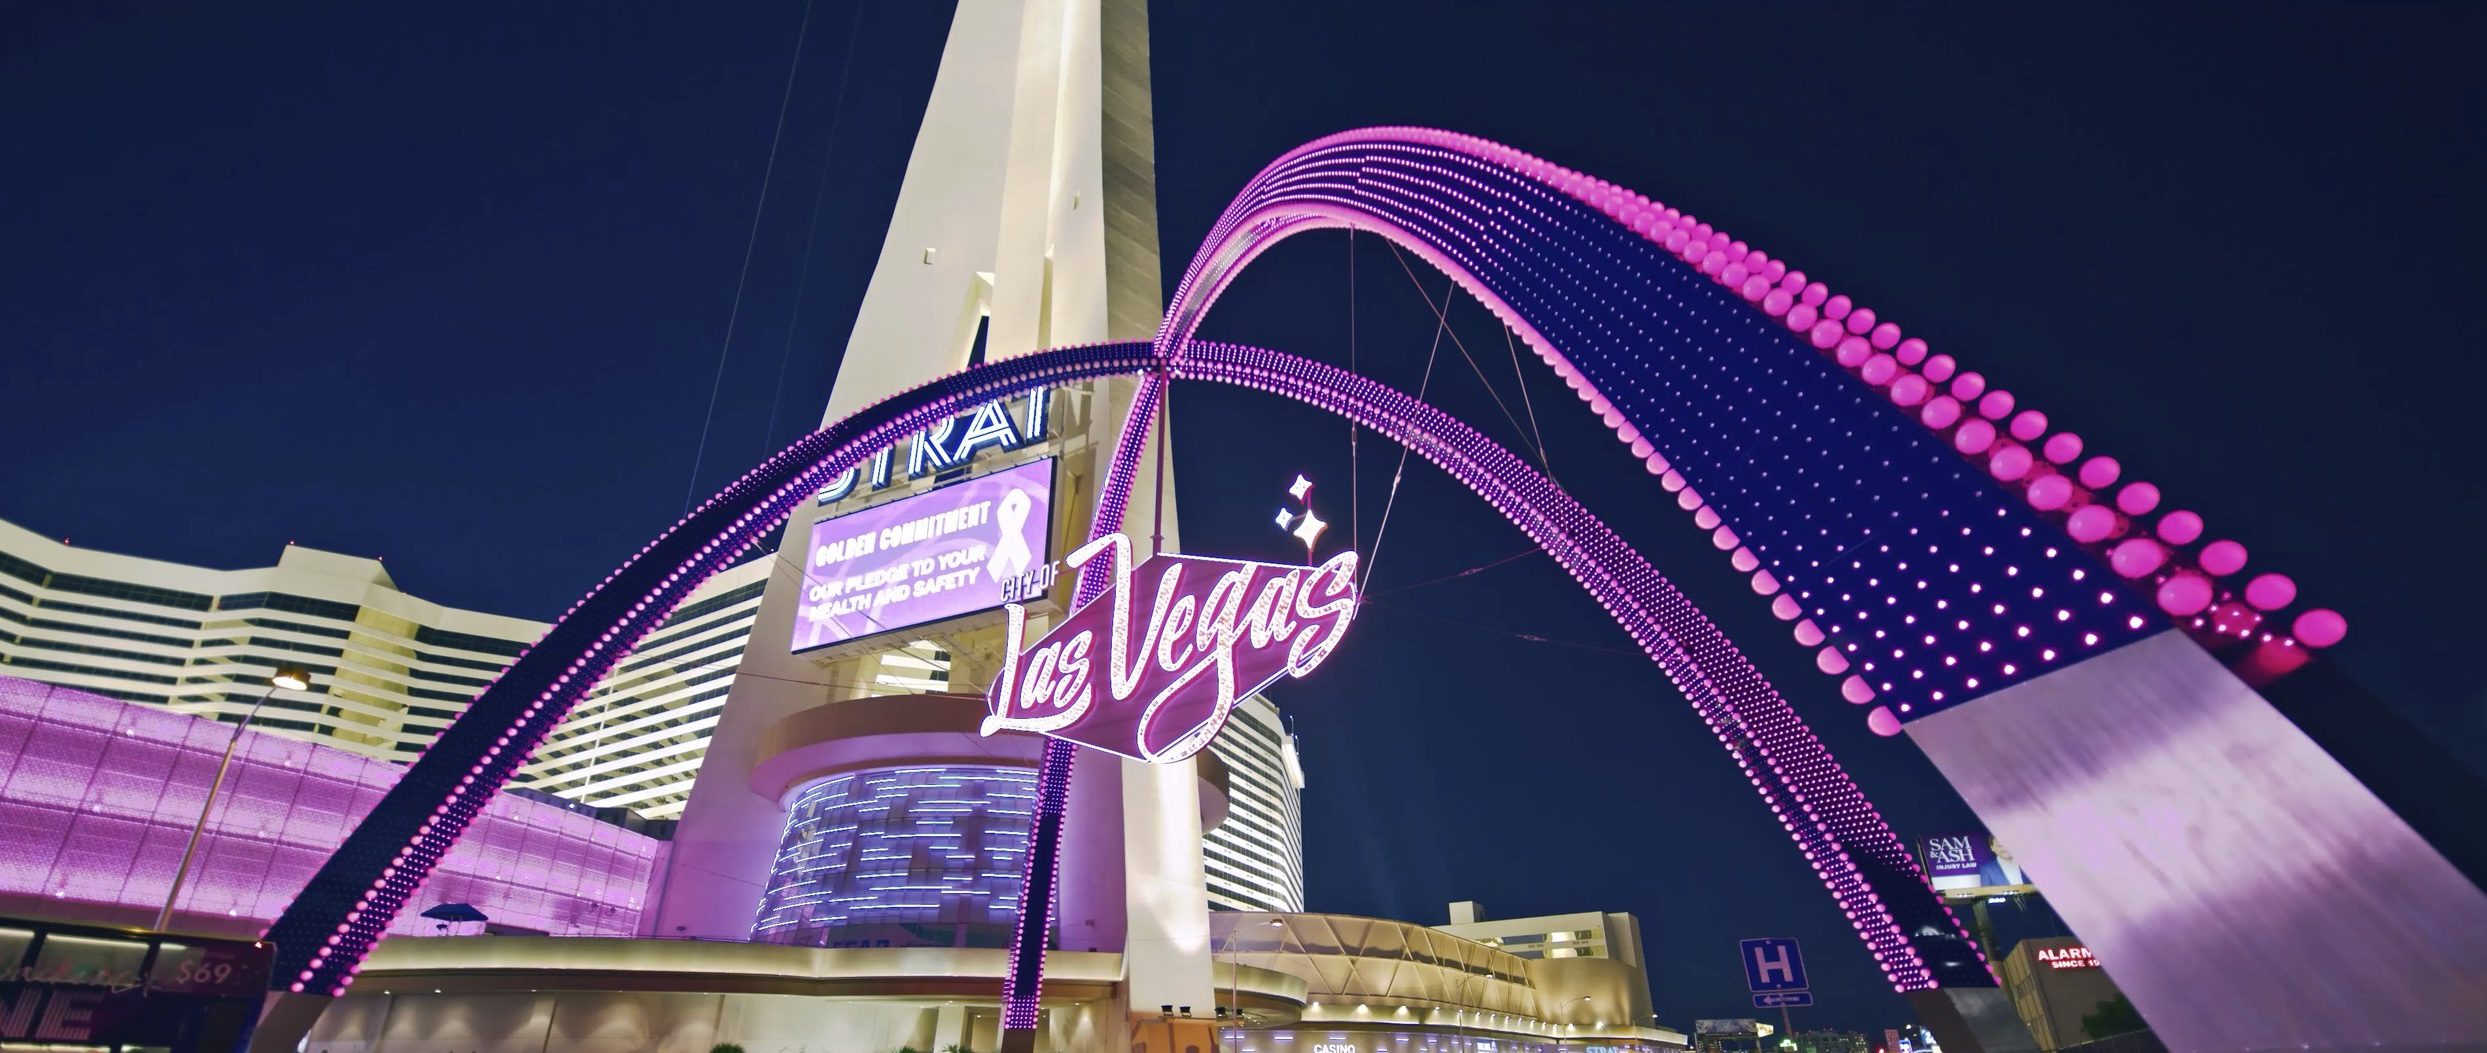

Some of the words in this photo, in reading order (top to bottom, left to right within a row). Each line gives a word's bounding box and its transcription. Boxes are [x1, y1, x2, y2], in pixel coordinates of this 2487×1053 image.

[815, 532, 877, 567] GOLDEN
[879, 500, 991, 551] COMMITMENT
[809, 581, 843, 602] OUR
[845, 561, 909, 592] PLEDGE
[912, 556, 935, 578] TO
[938, 545, 986, 573] YOUR
[1000, 569, 1036, 603] CITY
[1039, 560, 1061, 589] OF
[808, 594, 871, 622] HEALTH
[873, 582, 911, 608] AND
[912, 566, 981, 598] SAFETY
[979, 603, 1093, 738] Las
[1065, 532, 1359, 765] Vegas
[1929, 836, 1971, 851] SAM
[176, 960, 231, 984] $69
[1754, 945, 1793, 983] H
[2051, 960, 2086, 968] SINCE
[1313, 1044, 1356, 1053] CASINO
